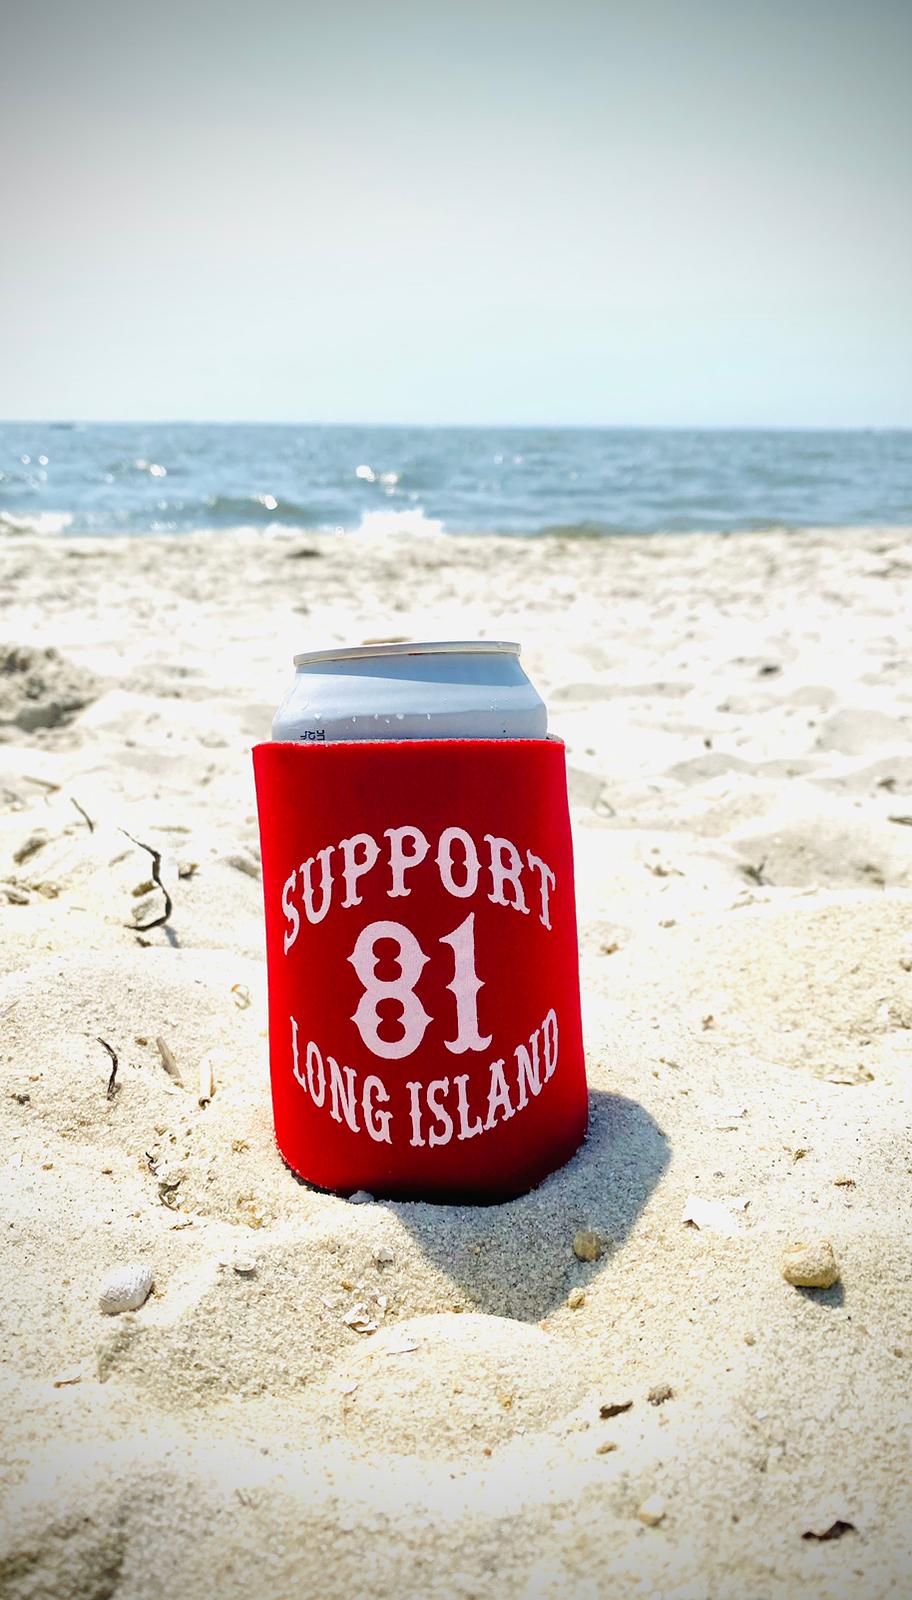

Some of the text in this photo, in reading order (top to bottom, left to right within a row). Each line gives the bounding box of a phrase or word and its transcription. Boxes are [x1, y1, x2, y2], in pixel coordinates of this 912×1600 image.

[281, 826, 556, 955] SUPPORT
[347, 911, 492, 1059] 81
[290, 1008, 559, 1147] LONG ISLAND
